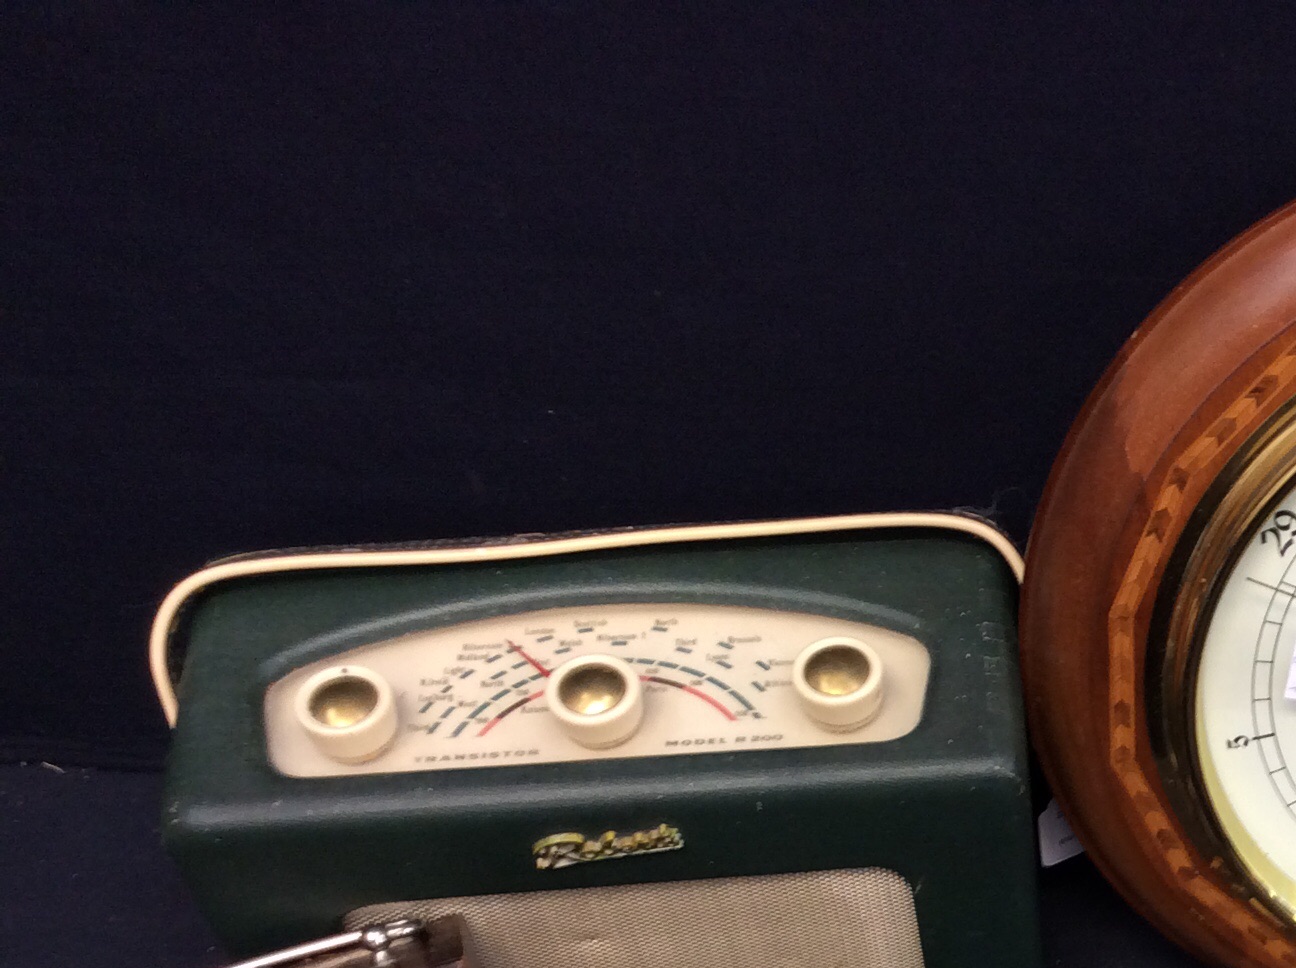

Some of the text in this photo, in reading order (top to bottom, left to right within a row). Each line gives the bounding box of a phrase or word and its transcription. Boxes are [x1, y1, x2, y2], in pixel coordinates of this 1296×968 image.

[665, 737, 727, 747] MODEL
[750, 733, 784, 743] 200
[1226, 734, 1249, 750] 5
[414, 748, 540, 763] TRANSISTOR
